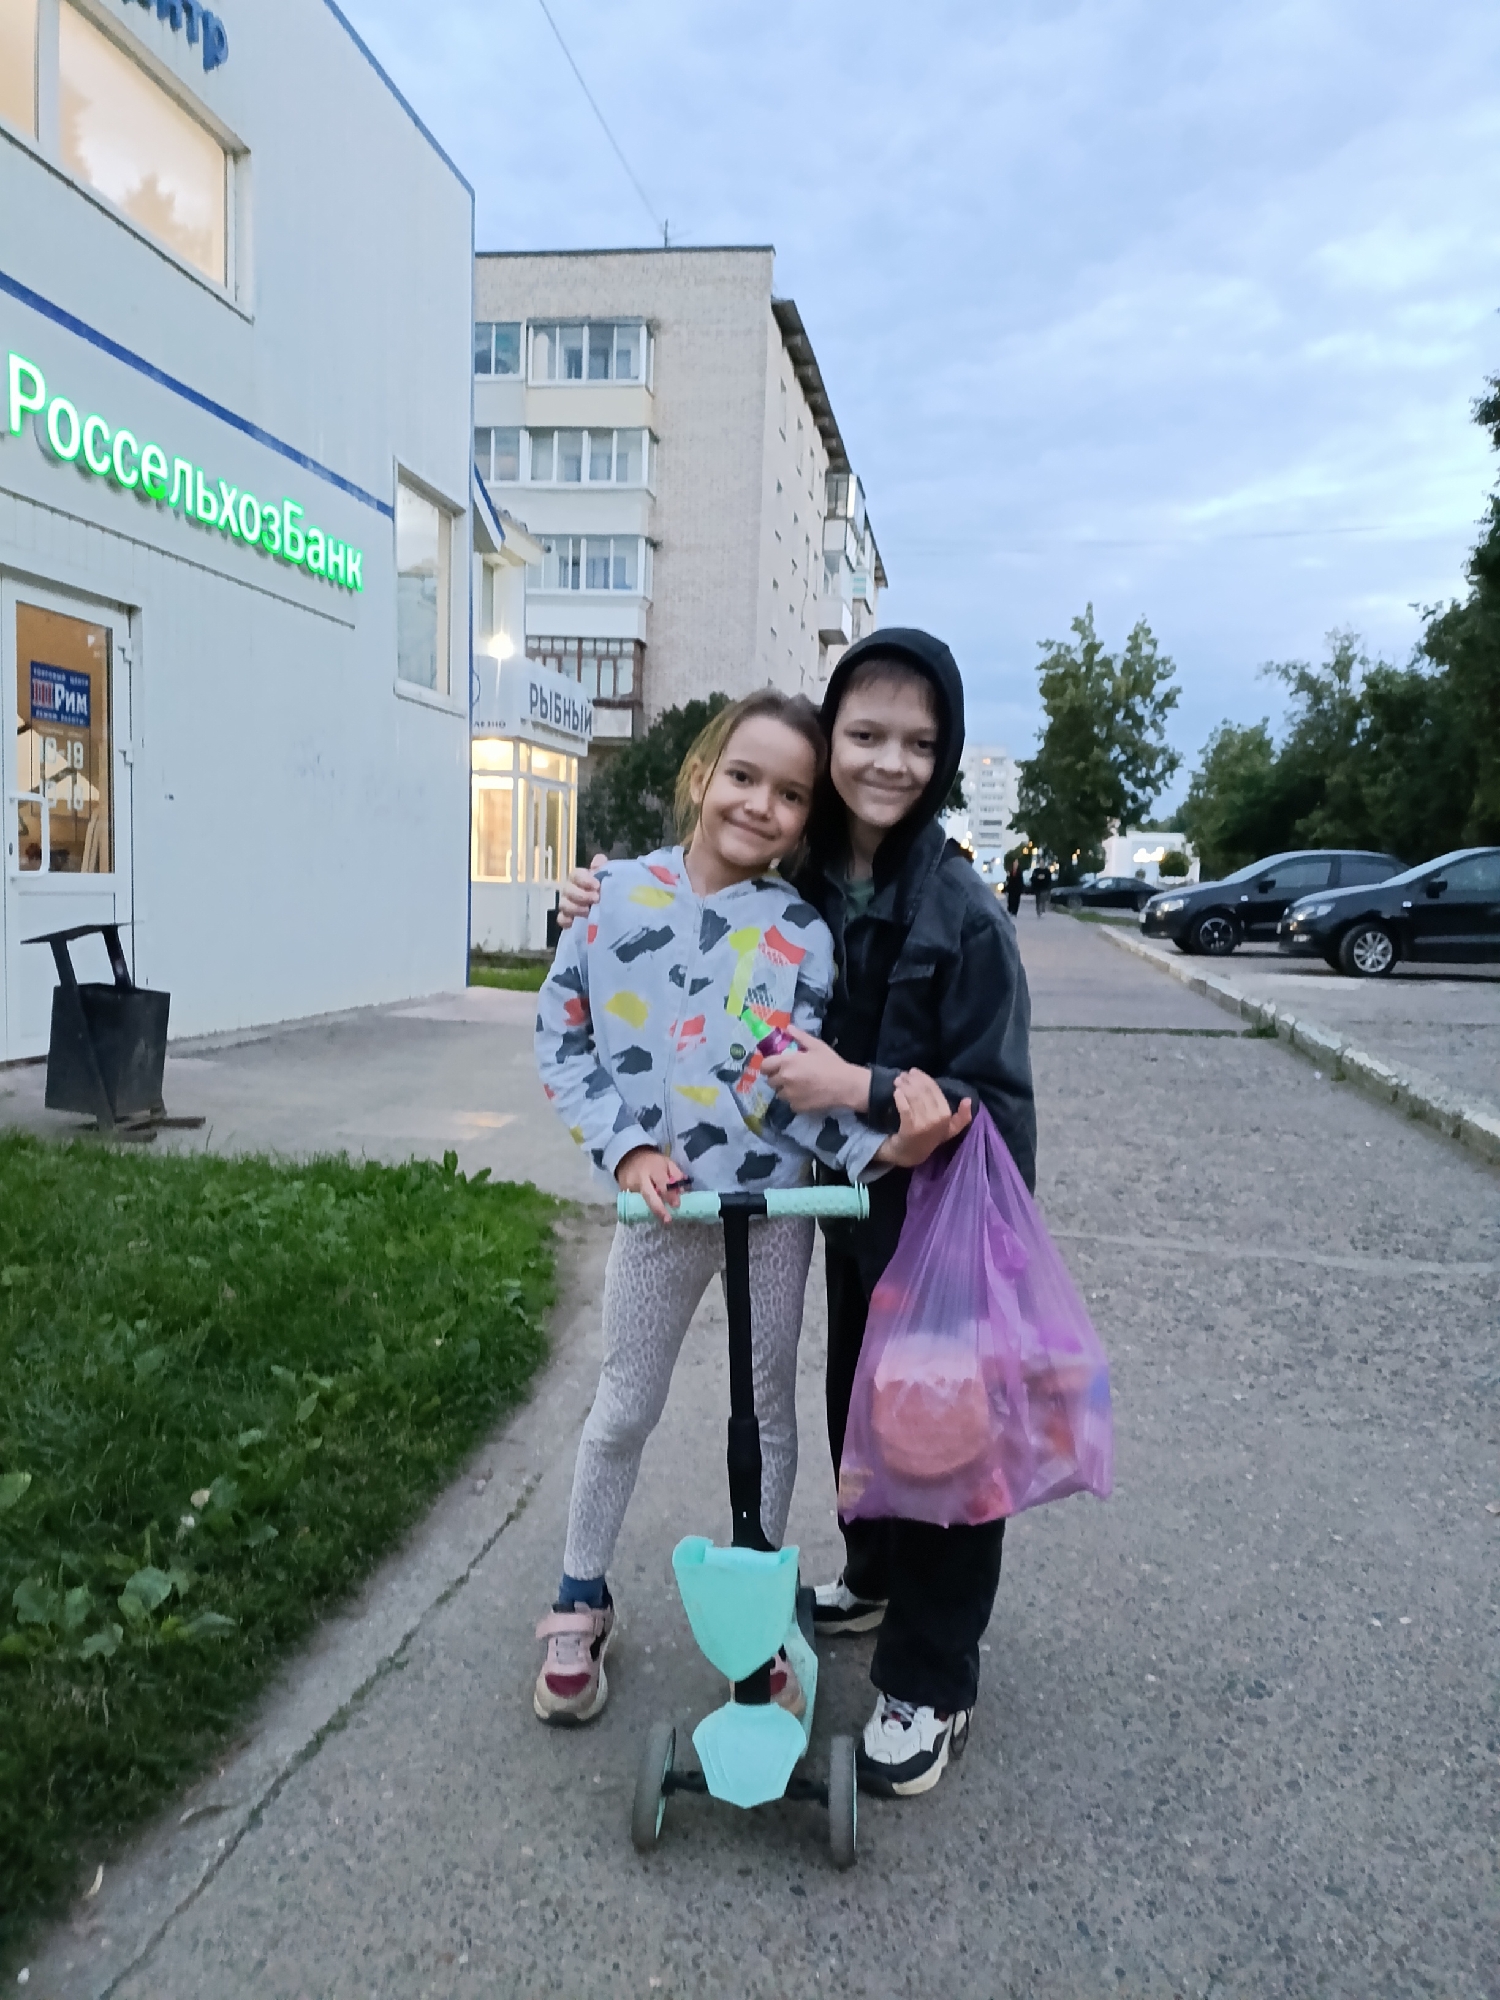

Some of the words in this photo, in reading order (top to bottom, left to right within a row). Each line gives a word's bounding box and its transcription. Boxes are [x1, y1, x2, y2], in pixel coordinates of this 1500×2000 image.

[121, 0, 229, 71] нтр
[8, 350, 364, 593] РоссельхозБанк
[529, 682, 593, 736] РЫБНЫЙ
